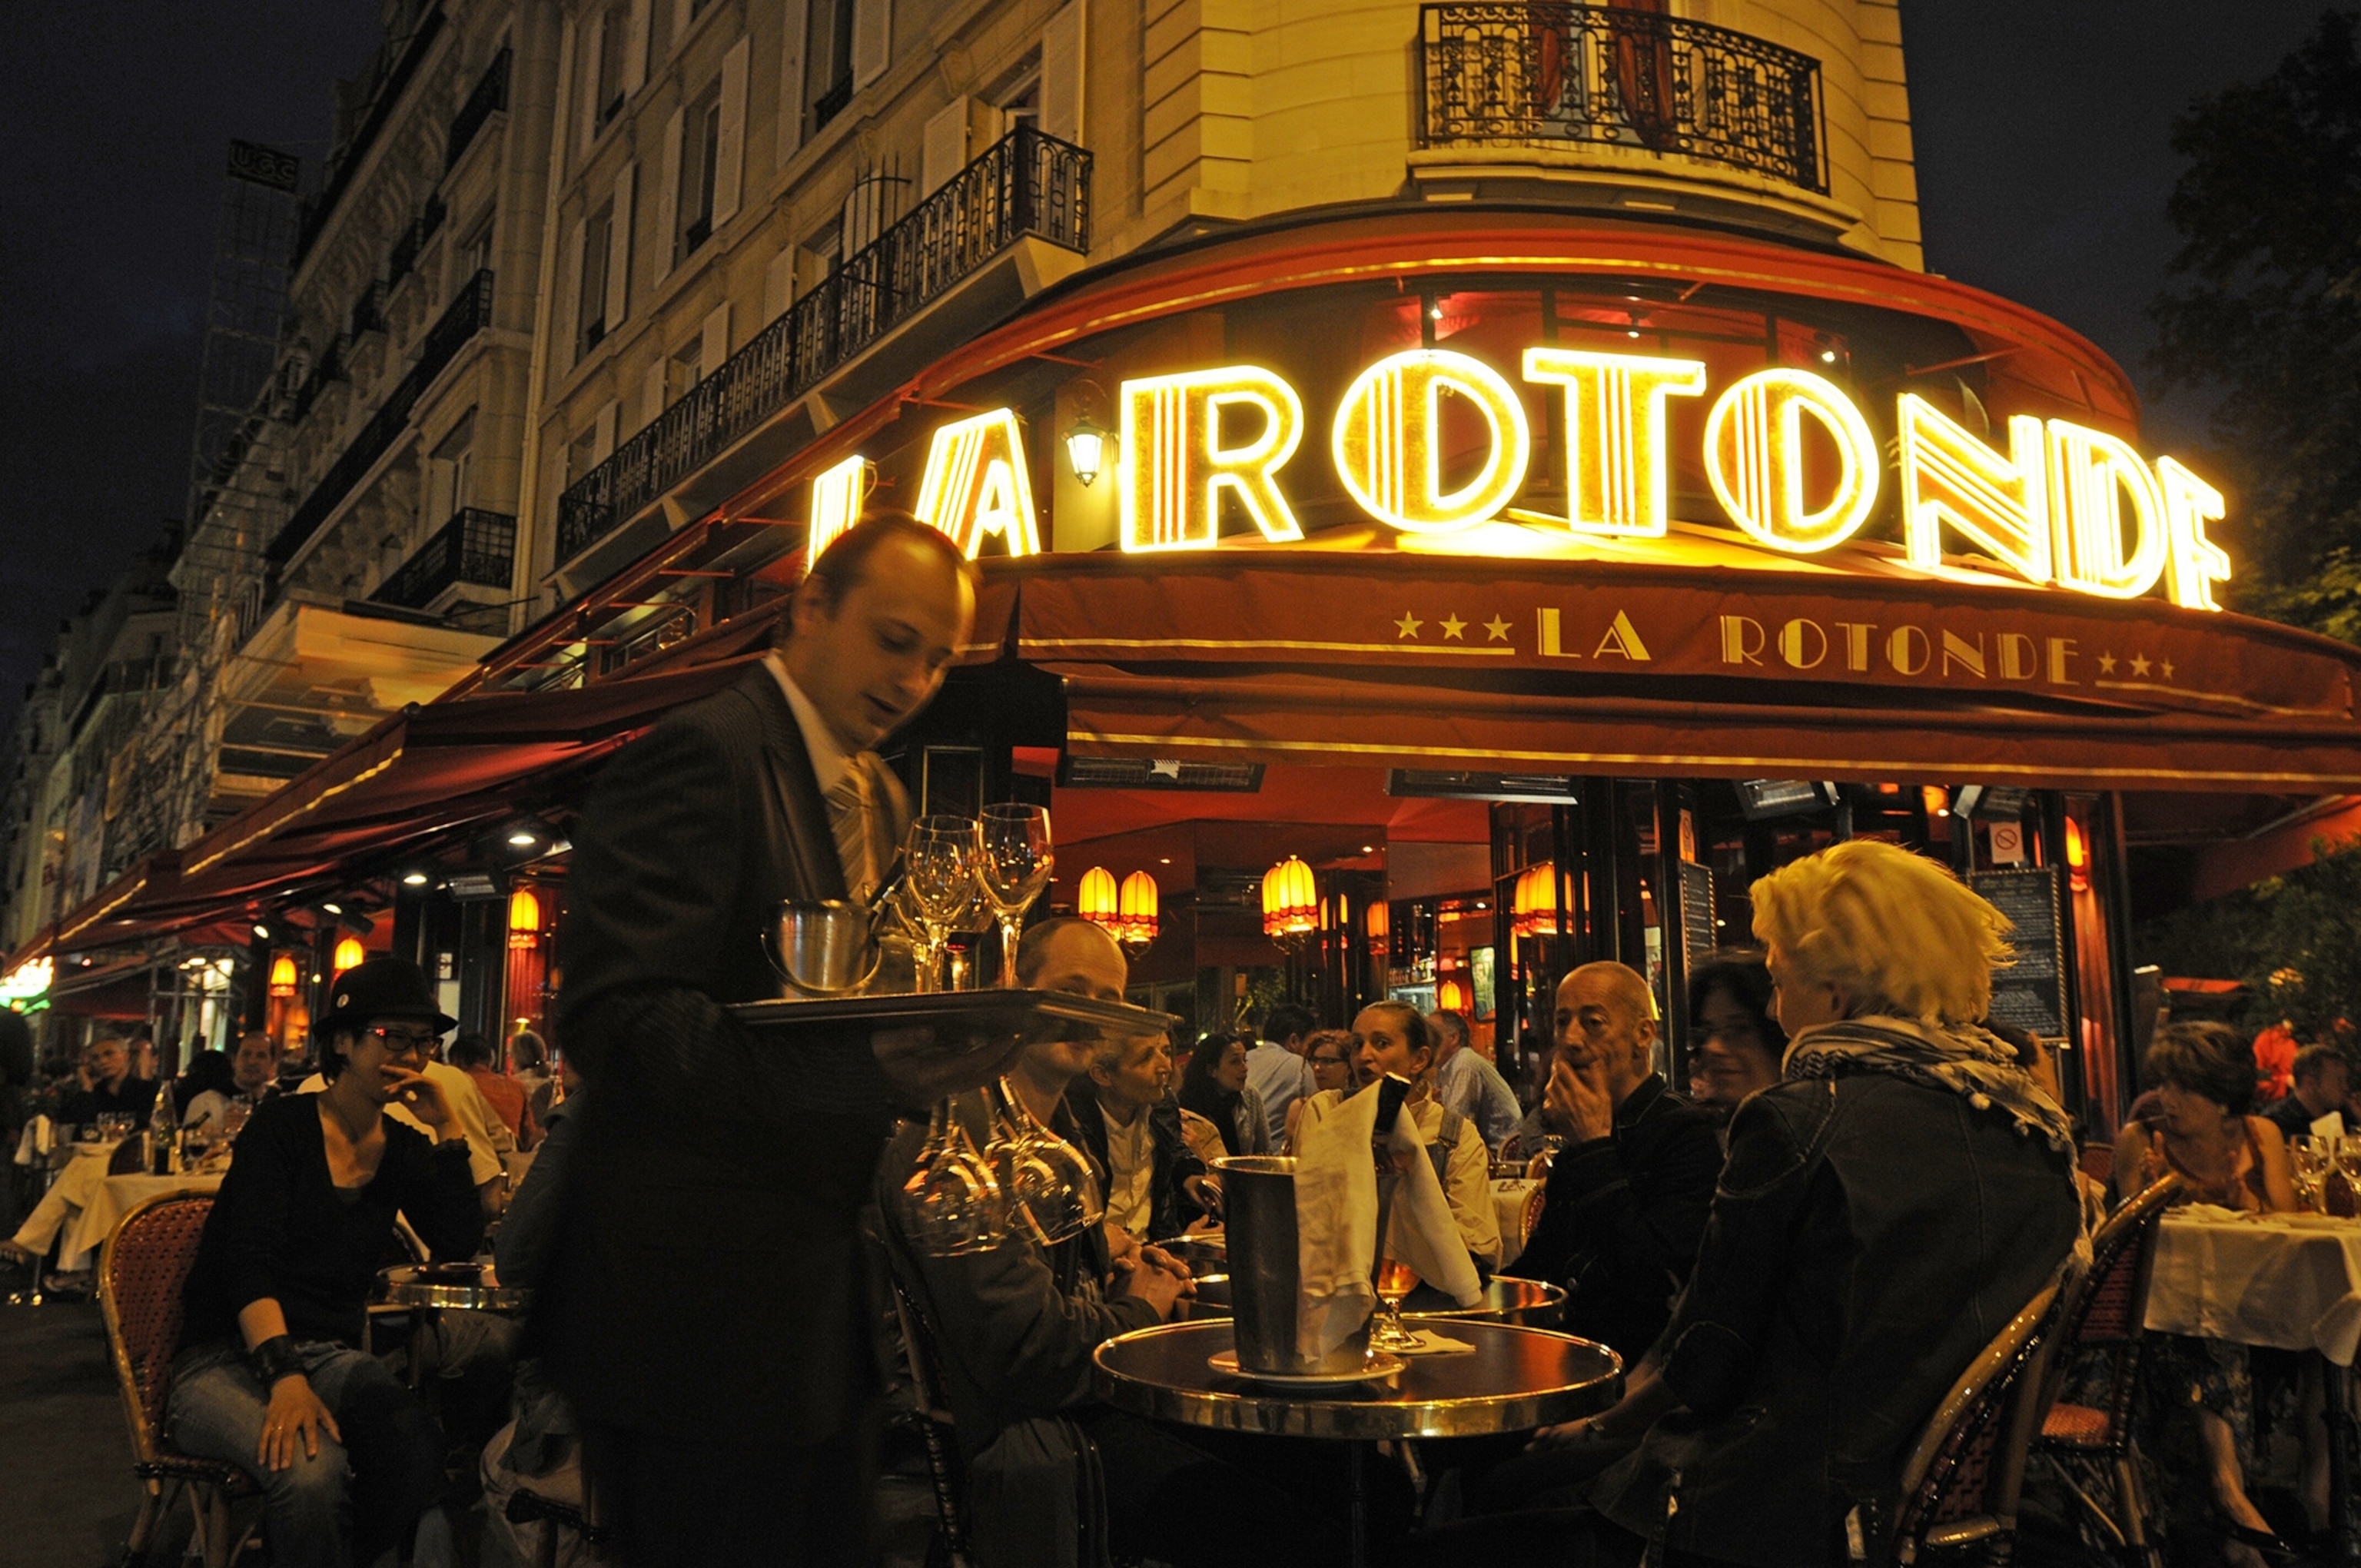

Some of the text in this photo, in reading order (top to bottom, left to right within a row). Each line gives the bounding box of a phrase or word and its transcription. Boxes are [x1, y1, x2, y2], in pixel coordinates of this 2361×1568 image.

[231, 145, 297, 181] UGC
[1119, 347, 2232, 613] ROTONDE
[1536, 606, 2081, 686] LA ROTONDE
